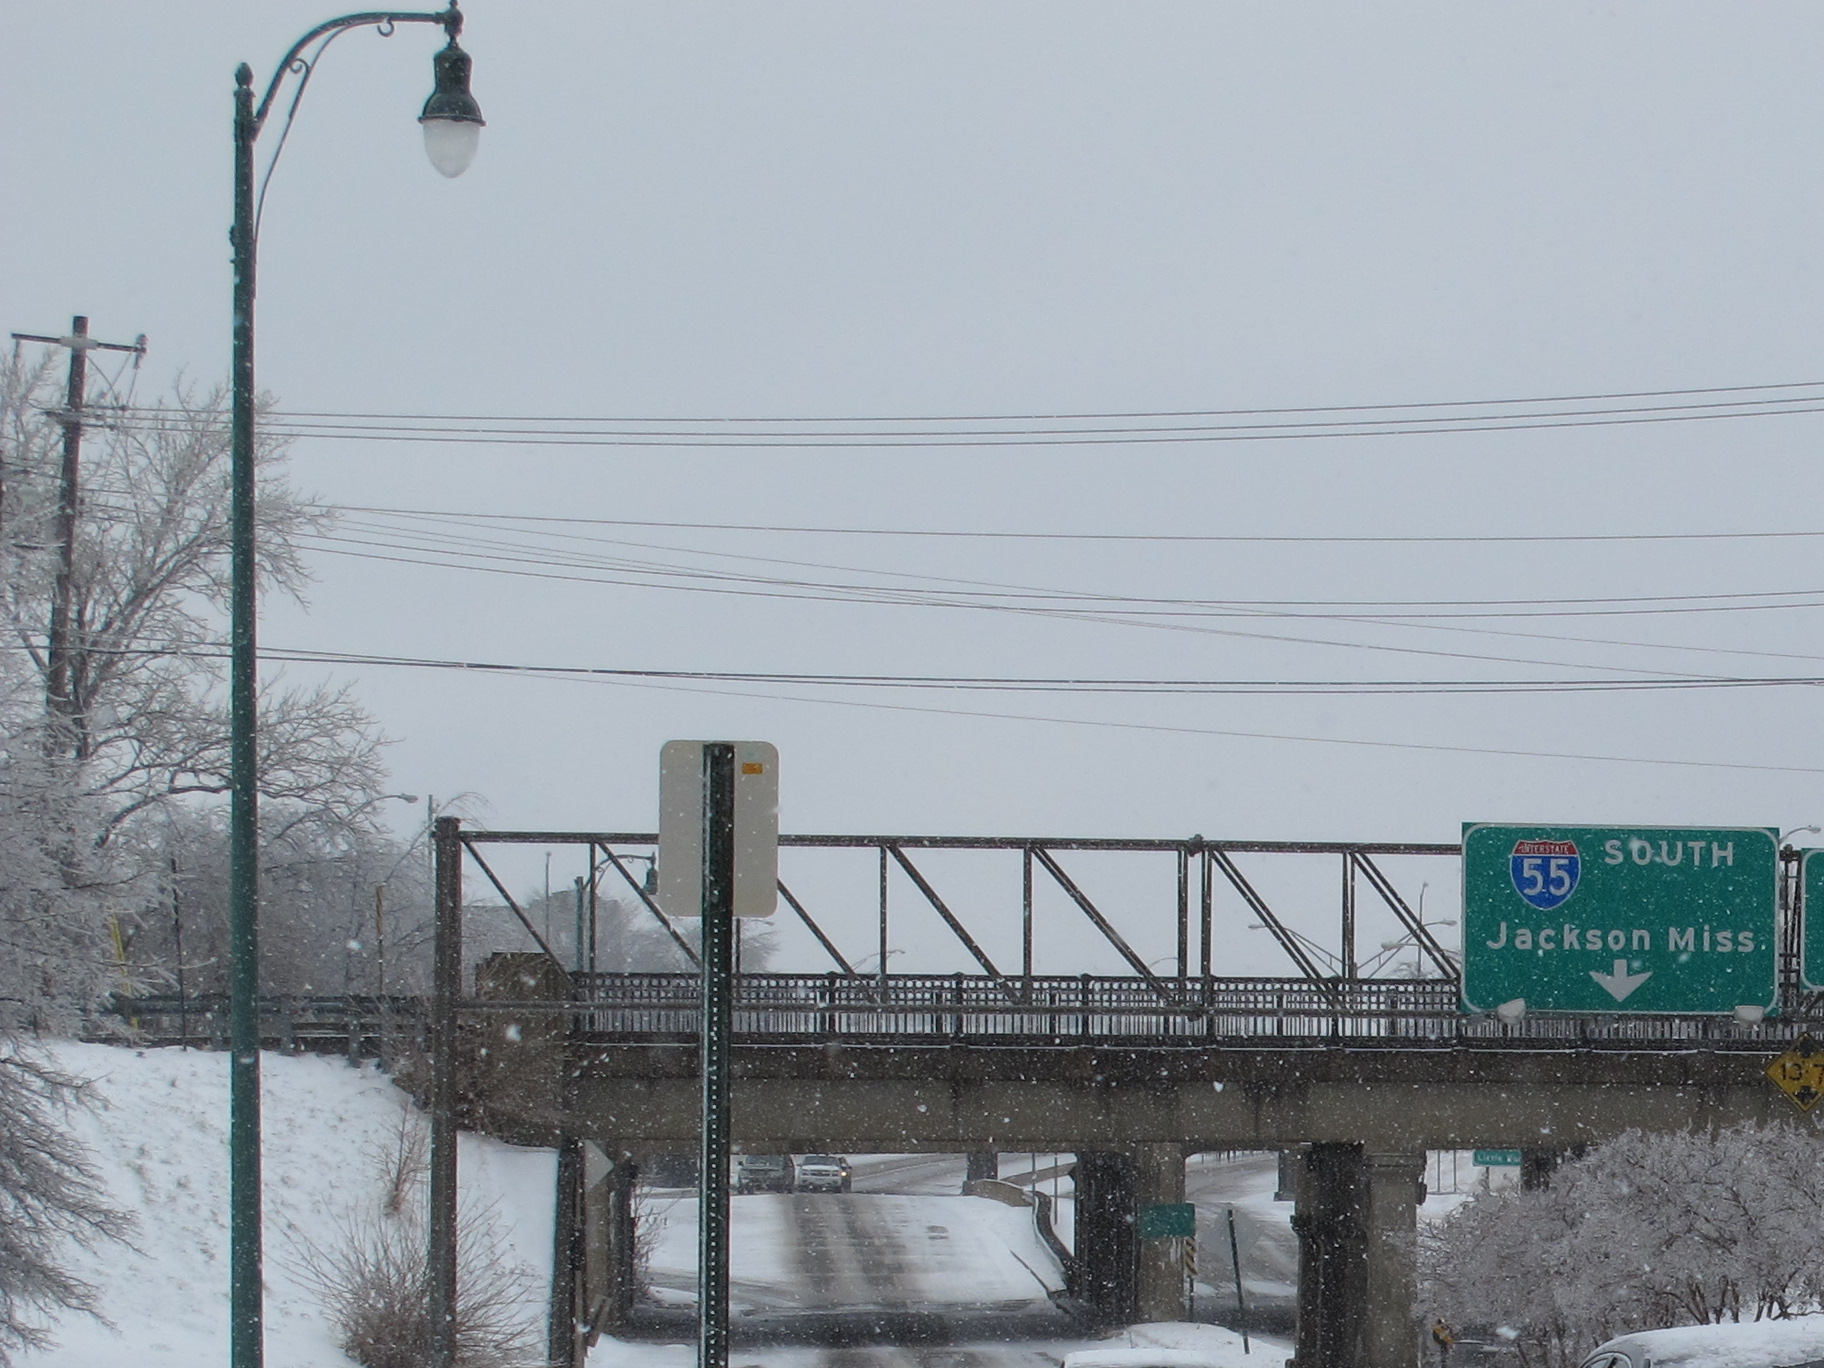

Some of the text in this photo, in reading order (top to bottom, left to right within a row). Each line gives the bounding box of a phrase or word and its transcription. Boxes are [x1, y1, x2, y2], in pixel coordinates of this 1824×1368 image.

[1521, 844, 1569, 855] INTERSTATE
[1604, 839, 1734, 867] SOUTH
[1523, 857, 1571, 897] 55
[1486, 921, 1755, 953] Jackson Miss
